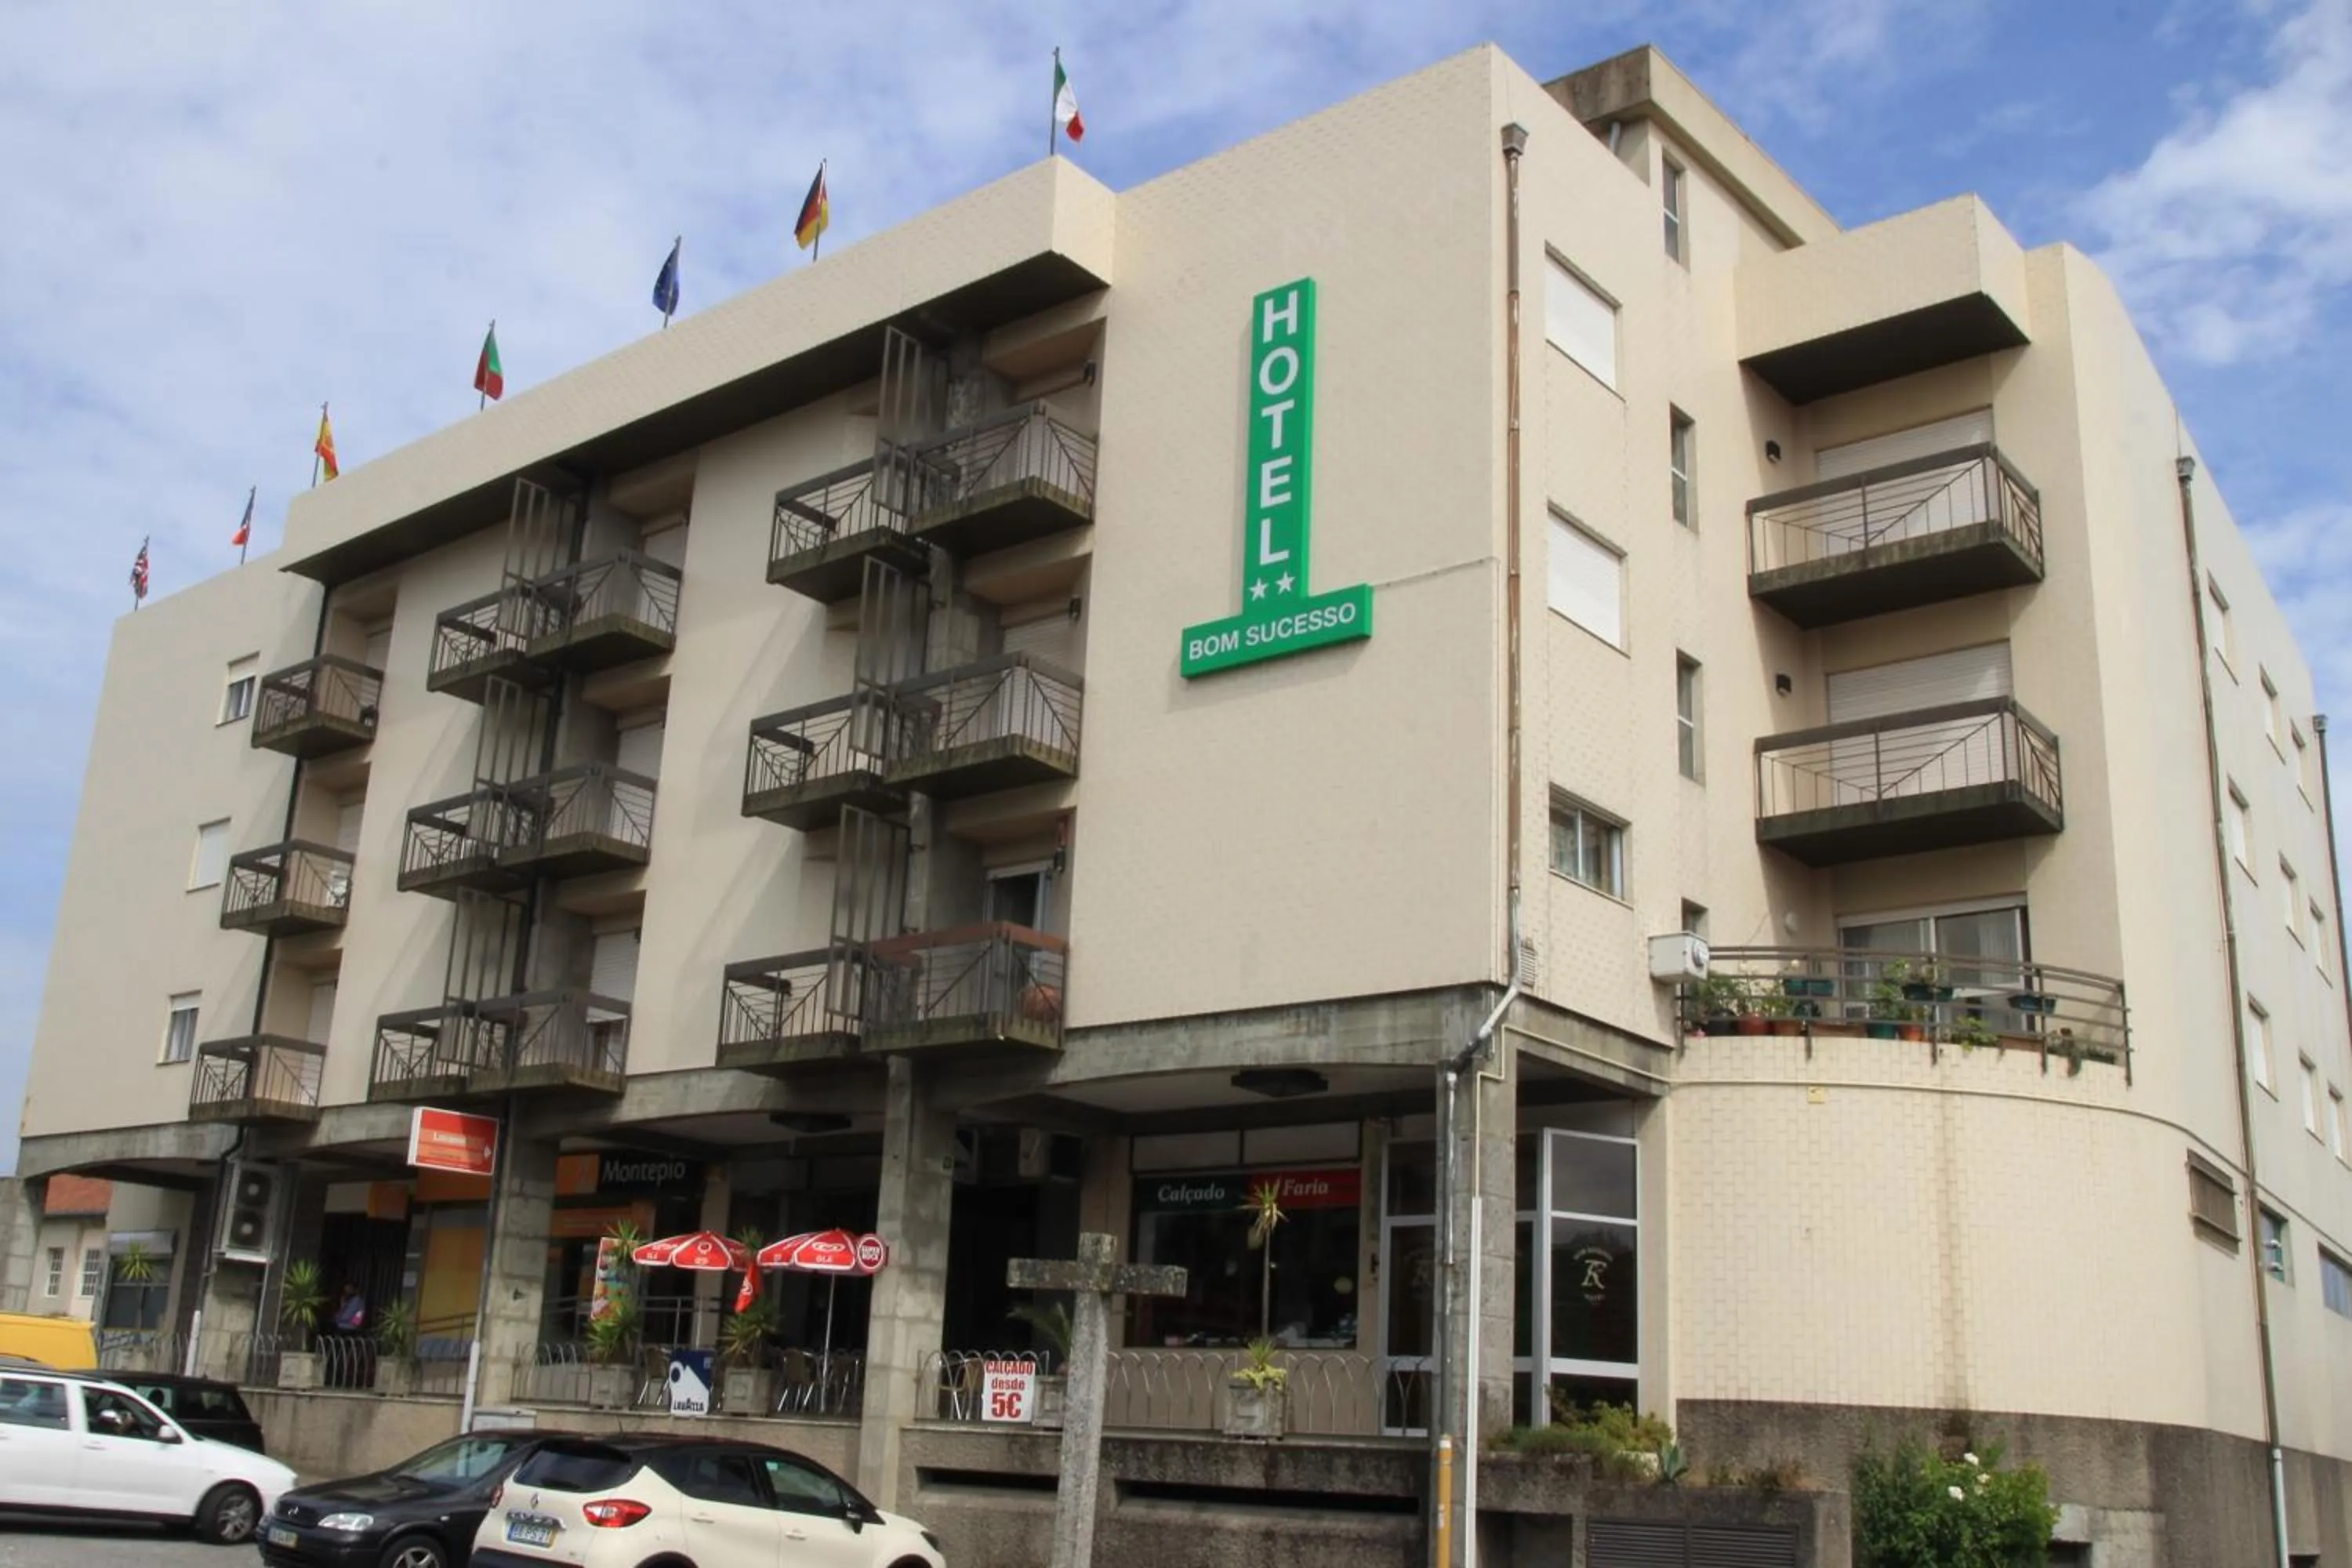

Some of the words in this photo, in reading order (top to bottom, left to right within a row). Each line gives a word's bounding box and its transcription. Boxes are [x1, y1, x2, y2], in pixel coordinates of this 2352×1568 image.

[1258, 289, 1300, 566] HOTEL
[1189, 630, 1240, 660] BOM
[1245, 602, 1356, 646] SUCESSO
[602, 1160, 686, 1187] Montepio
[1157, 1182, 1225, 1204] Calçado
[1283, 1178, 1329, 1196] Faria
